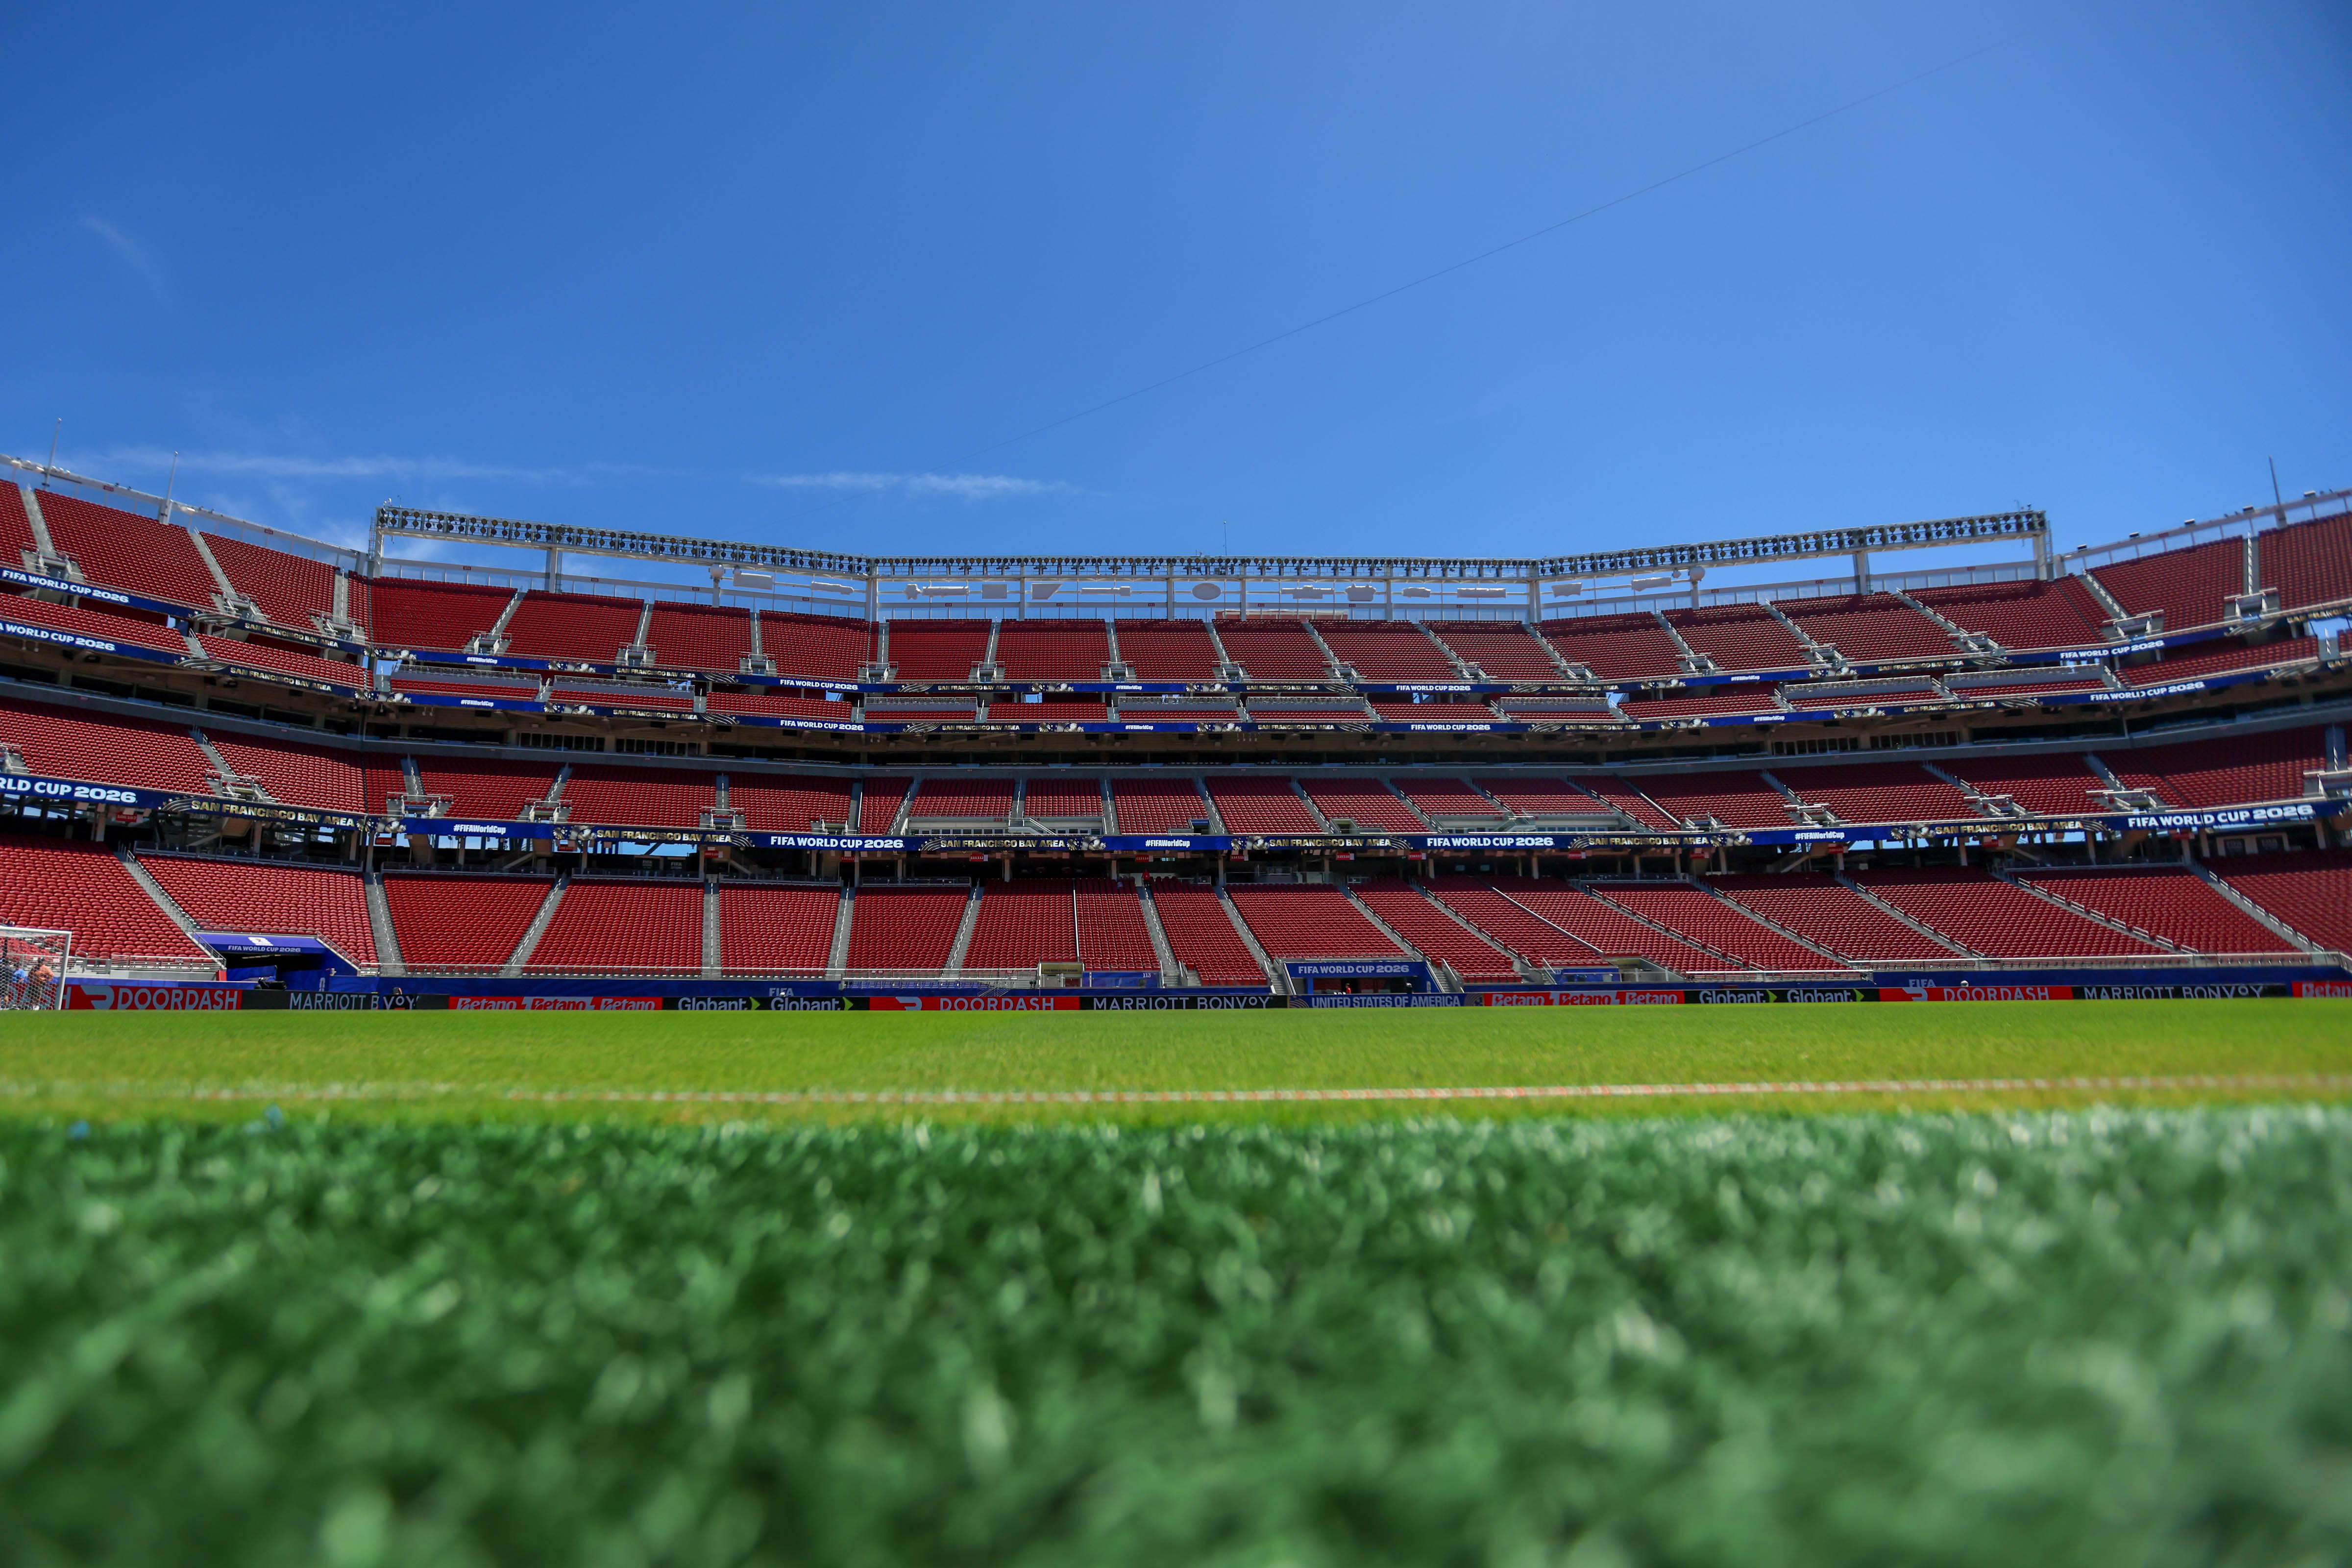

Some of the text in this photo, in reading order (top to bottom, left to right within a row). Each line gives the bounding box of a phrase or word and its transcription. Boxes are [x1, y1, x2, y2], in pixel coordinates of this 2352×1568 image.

[2, 570, 129, 603] FIFA WORLD CUP 2026
[5, 624, 49, 638] WORLD
[50, 633, 74, 643] CUP
[75, 638, 115, 651] 2026
[2060, 640, 2164, 659] FIFA WORLD CUP 2026
[2090, 692, 2109, 701] FIFA
[2147, 687, 2167, 696] CUP
[2168, 681, 2205, 693] 2026
[0, 778, 137, 803] RLD CUP 2026
[191, 800, 354, 827] SAN FRANCISCO BAY AREA
[2128, 805, 2314, 827] FIFA WORLD CUP 2026
[453, 824, 506, 834] #FIFAWorldCup
[1935, 821, 2082, 834] SAN FRANCISCO BAY AREA
[596, 830, 732, 842] SAN FRANCISCO BAY AREA
[770, 836, 904, 849] FIFA WORLD CUP 2026
[1427, 837, 1554, 846] FIFA WORLD CUP 2026
[1795, 832, 1845, 840] #FIFAWorldCup
[118, 987, 238, 1009] DOORDASH
[769, 988, 794, 997] FIFA
[1492, 992, 1678, 1006] Betano Betano Betano
[1943, 987, 2050, 1001] DOORDASH
[2084, 986, 2174, 1000] MARRIOTT
[290, 993, 366, 1009] MARRIOTT
[457, 998, 655, 1010] Betano Betano Betano
[940, 998, 1054, 1010] DOORDASH
[1094, 997, 1189, 1009] MARRIOTT
[1312, 996, 1460, 1007] UNITED STATES OF AMERICA
